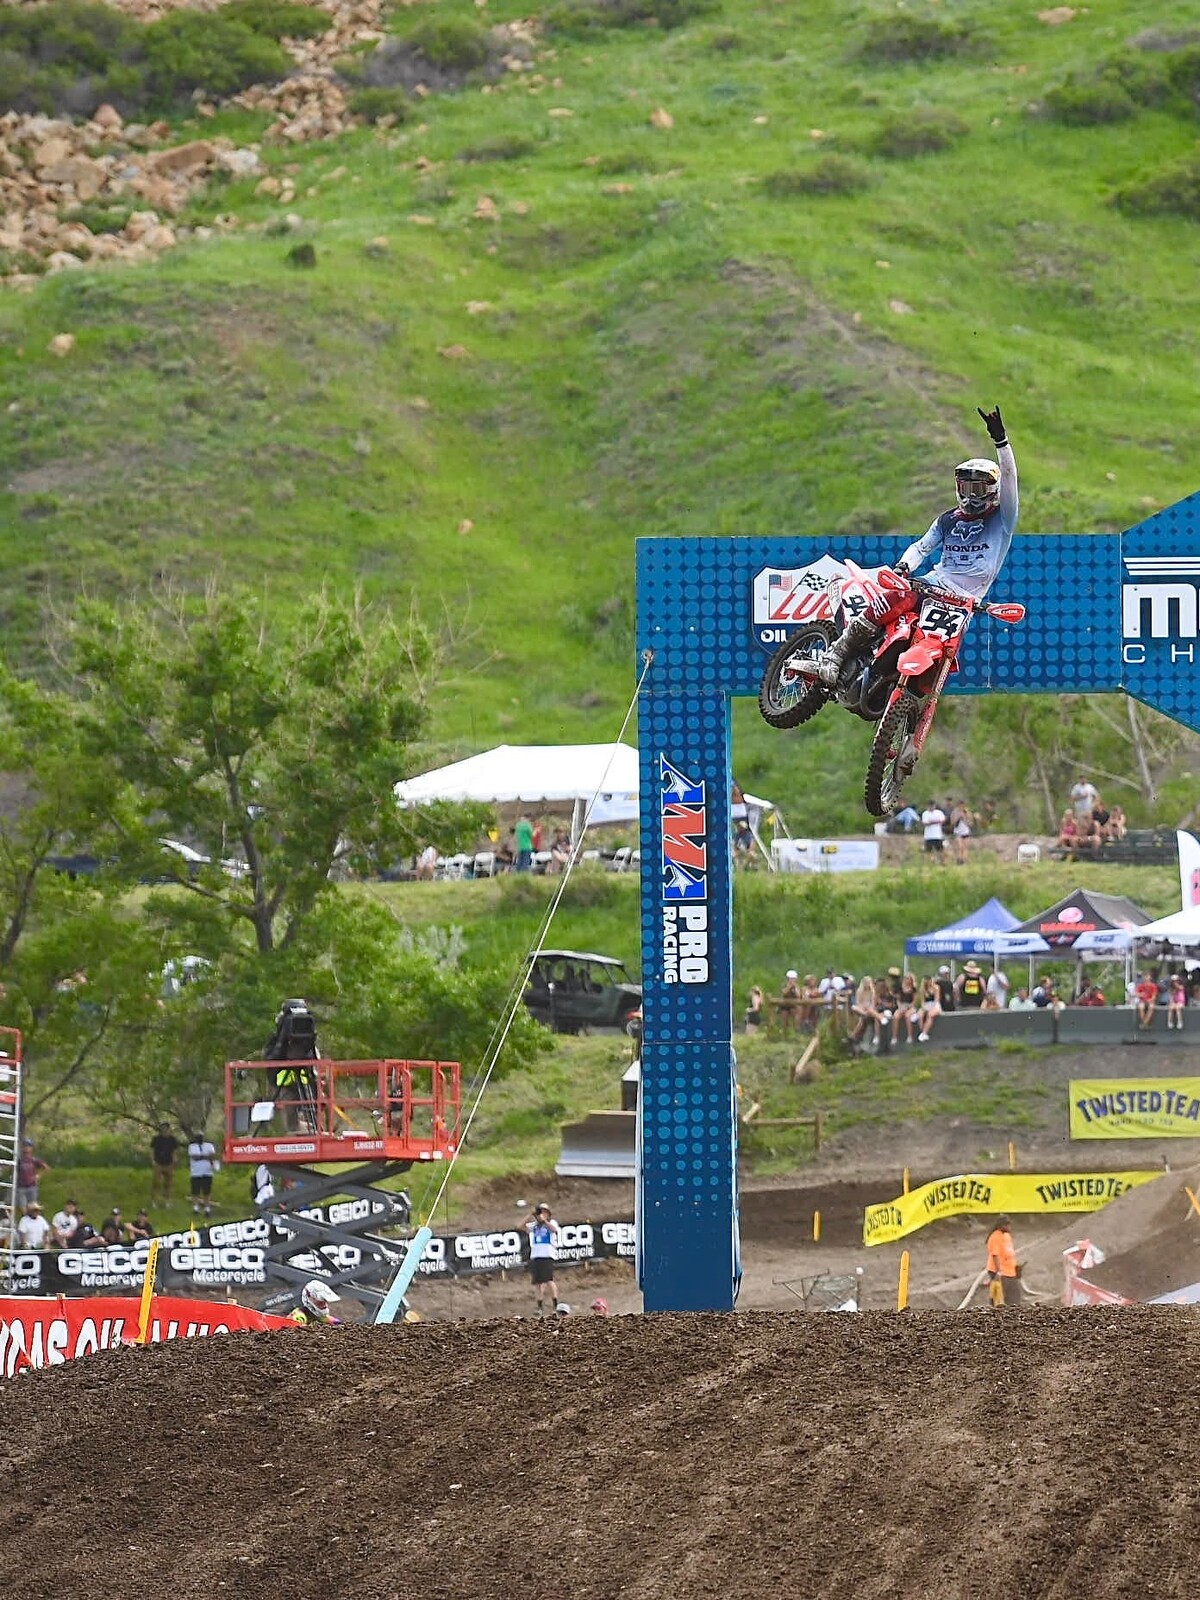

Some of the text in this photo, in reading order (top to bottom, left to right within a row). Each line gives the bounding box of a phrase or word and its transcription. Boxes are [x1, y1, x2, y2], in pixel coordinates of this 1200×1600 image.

[945, 543, 990, 552] HONDA
[770, 593, 834, 620] LUC
[921, 608, 961, 639] 94
[660, 752, 708, 900] AMA
[662, 906, 678, 984] RACING
[679, 905, 708, 984] PRO
[927, 941, 963, 953] YAMAHA
[1077, 1090, 1200, 1122] TWISTED TEA
[924, 1180, 991, 1213] TWISTED TEA
[1036, 1179, 1104, 1204] TWISTED
[209, 1219, 270, 1246] GEICO
[455, 1232, 521, 1258] GEICO
[602, 1223, 636, 1244] GEI
[58, 1249, 149, 1275] GEICO
[170, 1248, 265, 1271] GEICO
[471, 1253, 522, 1270] Motorcycle
[553, 1244, 594, 1260] otorcycle
[81, 1273, 145, 1287] Motorcyc
[193, 1269, 265, 1285] Motorcycle
